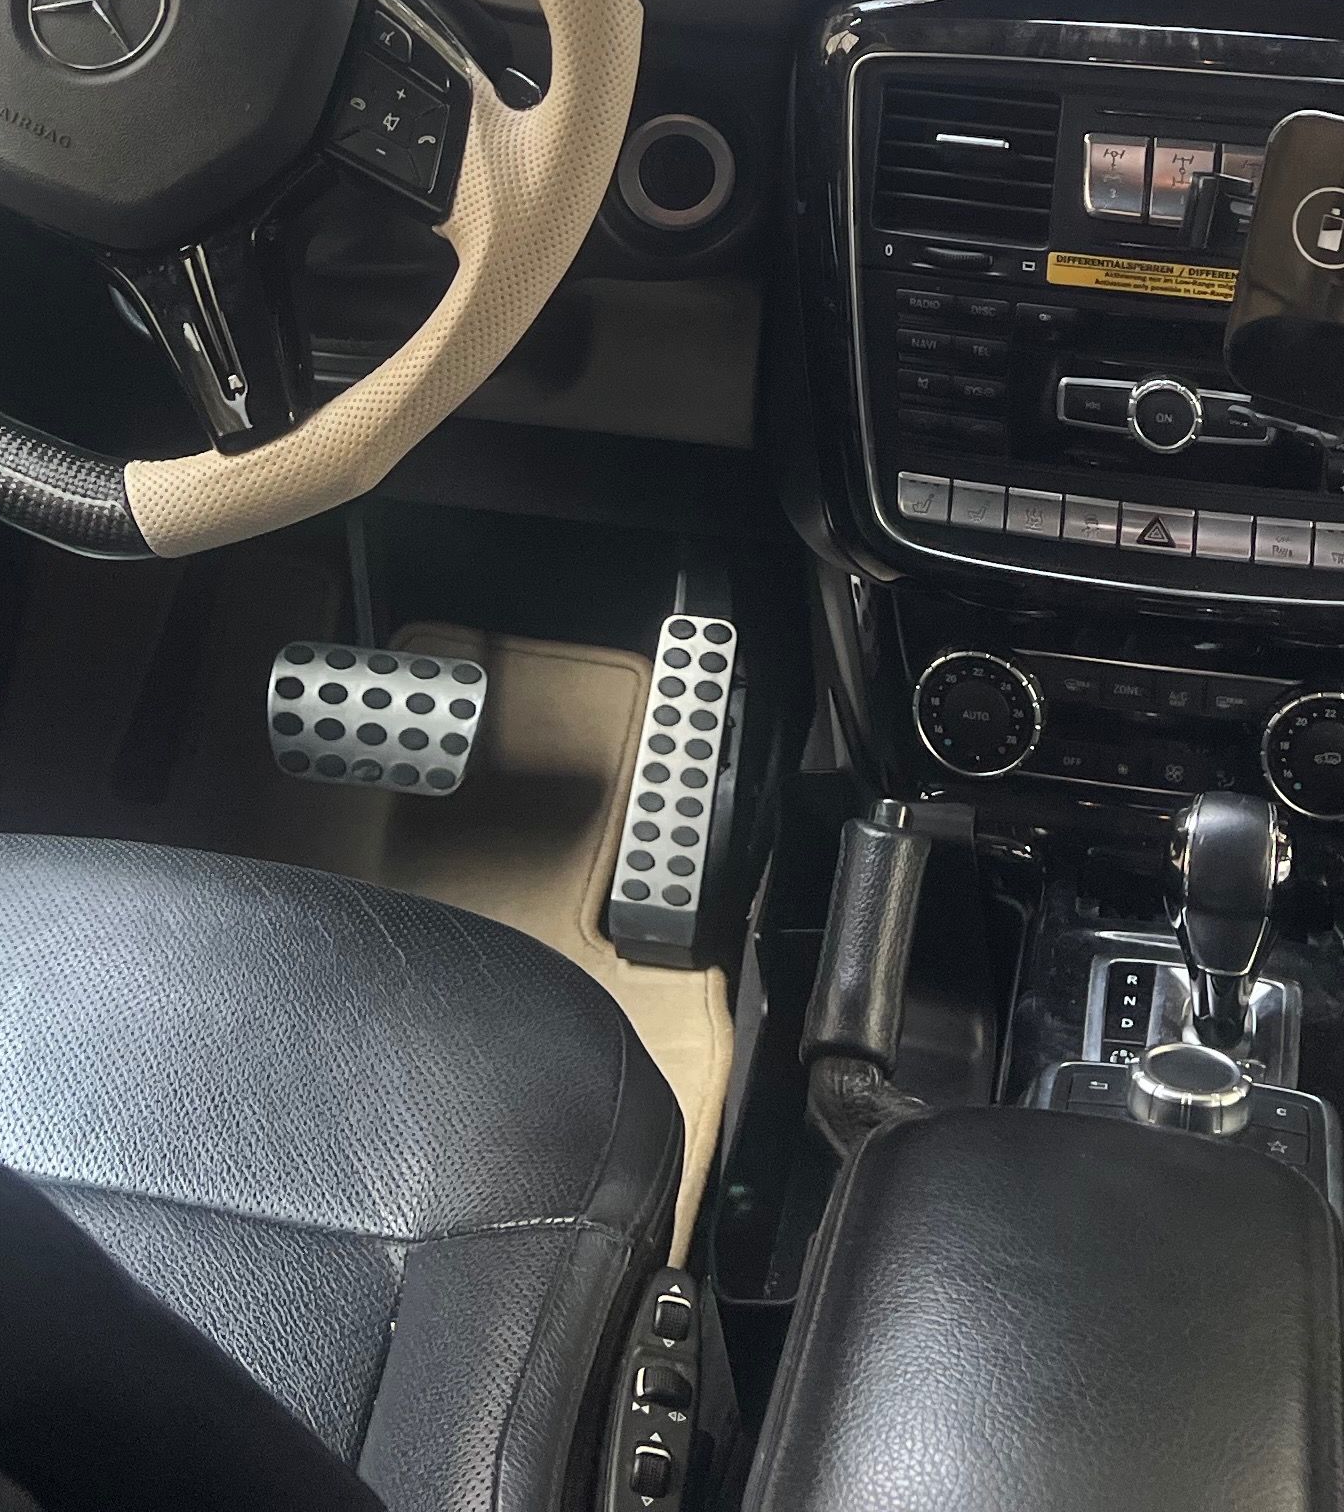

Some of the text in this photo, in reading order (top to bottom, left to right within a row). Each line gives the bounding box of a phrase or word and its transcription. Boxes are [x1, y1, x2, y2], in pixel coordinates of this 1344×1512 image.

[1056, 255, 1174, 274] DIFFERENTIALSPERREN
[1175, 278, 1216, 289] Low-Range
[909, 297, 941, 310] RADIO
[970, 305, 997, 317] DISC
[911, 338, 937, 350] NAVI
[972, 345, 990, 356] TEL
[1156, 413, 1174, 423] ON
[972, 668, 984, 677] 22
[945, 674, 957, 683] 20
[962, 710, 990, 721] AUTO
[1325, 709, 1337, 718] 22
[1295, 717, 1308, 727] 20
[1063, 756, 1082, 766] OFF
[1127, 975, 1138, 985] R
[1123, 996, 1136, 1006] N
[1121, 1018, 1134, 1028] D
[1276, 1107, 1287, 1116] C
